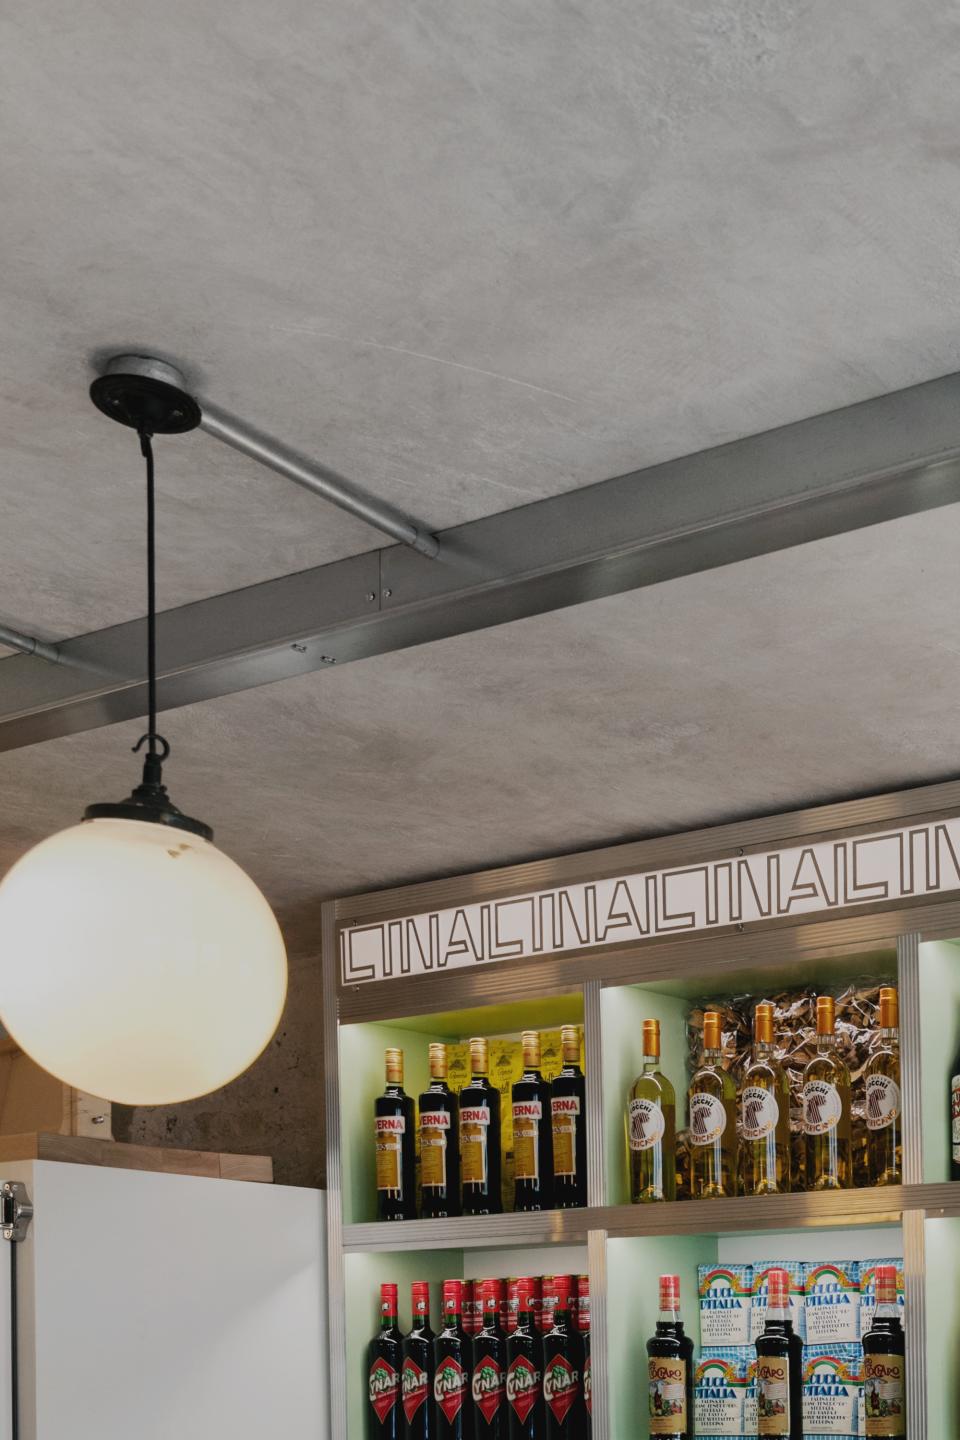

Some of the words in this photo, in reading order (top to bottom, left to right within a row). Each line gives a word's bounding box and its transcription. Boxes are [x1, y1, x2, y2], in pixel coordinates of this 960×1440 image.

[434, 1372, 469, 1401] CYNAR
[506, 1371, 541, 1401] CYNAR
[543, 1371, 579, 1401] CYNAR
